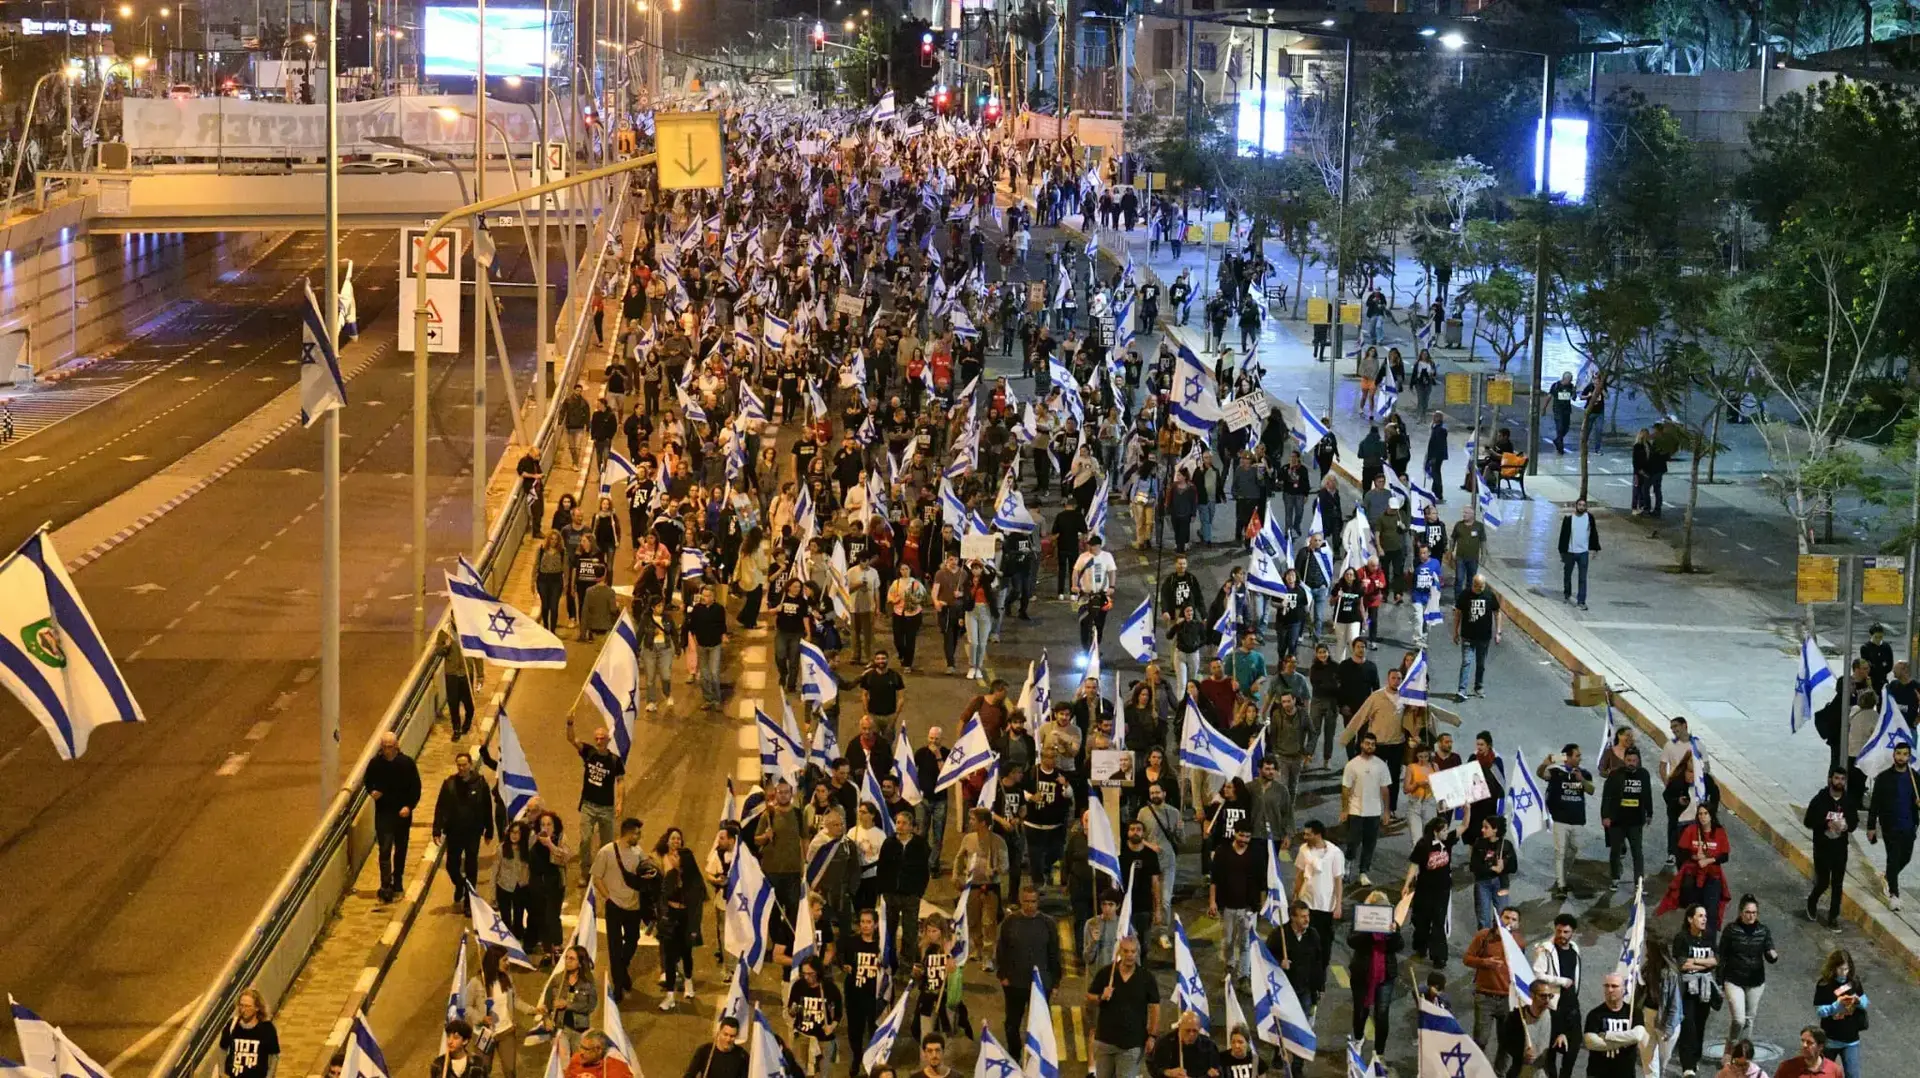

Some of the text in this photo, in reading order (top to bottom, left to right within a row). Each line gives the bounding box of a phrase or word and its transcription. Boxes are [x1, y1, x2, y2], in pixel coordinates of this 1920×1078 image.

[1038, 780, 1056, 792] דמו
[1226, 808, 1246, 819] דמו
[857, 952, 876, 966] דמו
[855, 976, 867, 988] יה
[1607, 1018, 1630, 1033] דמו
[234, 1038, 260, 1053] דמו
[233, 1052, 259, 1069] קרט
[231, 1065, 244, 1077] יה
